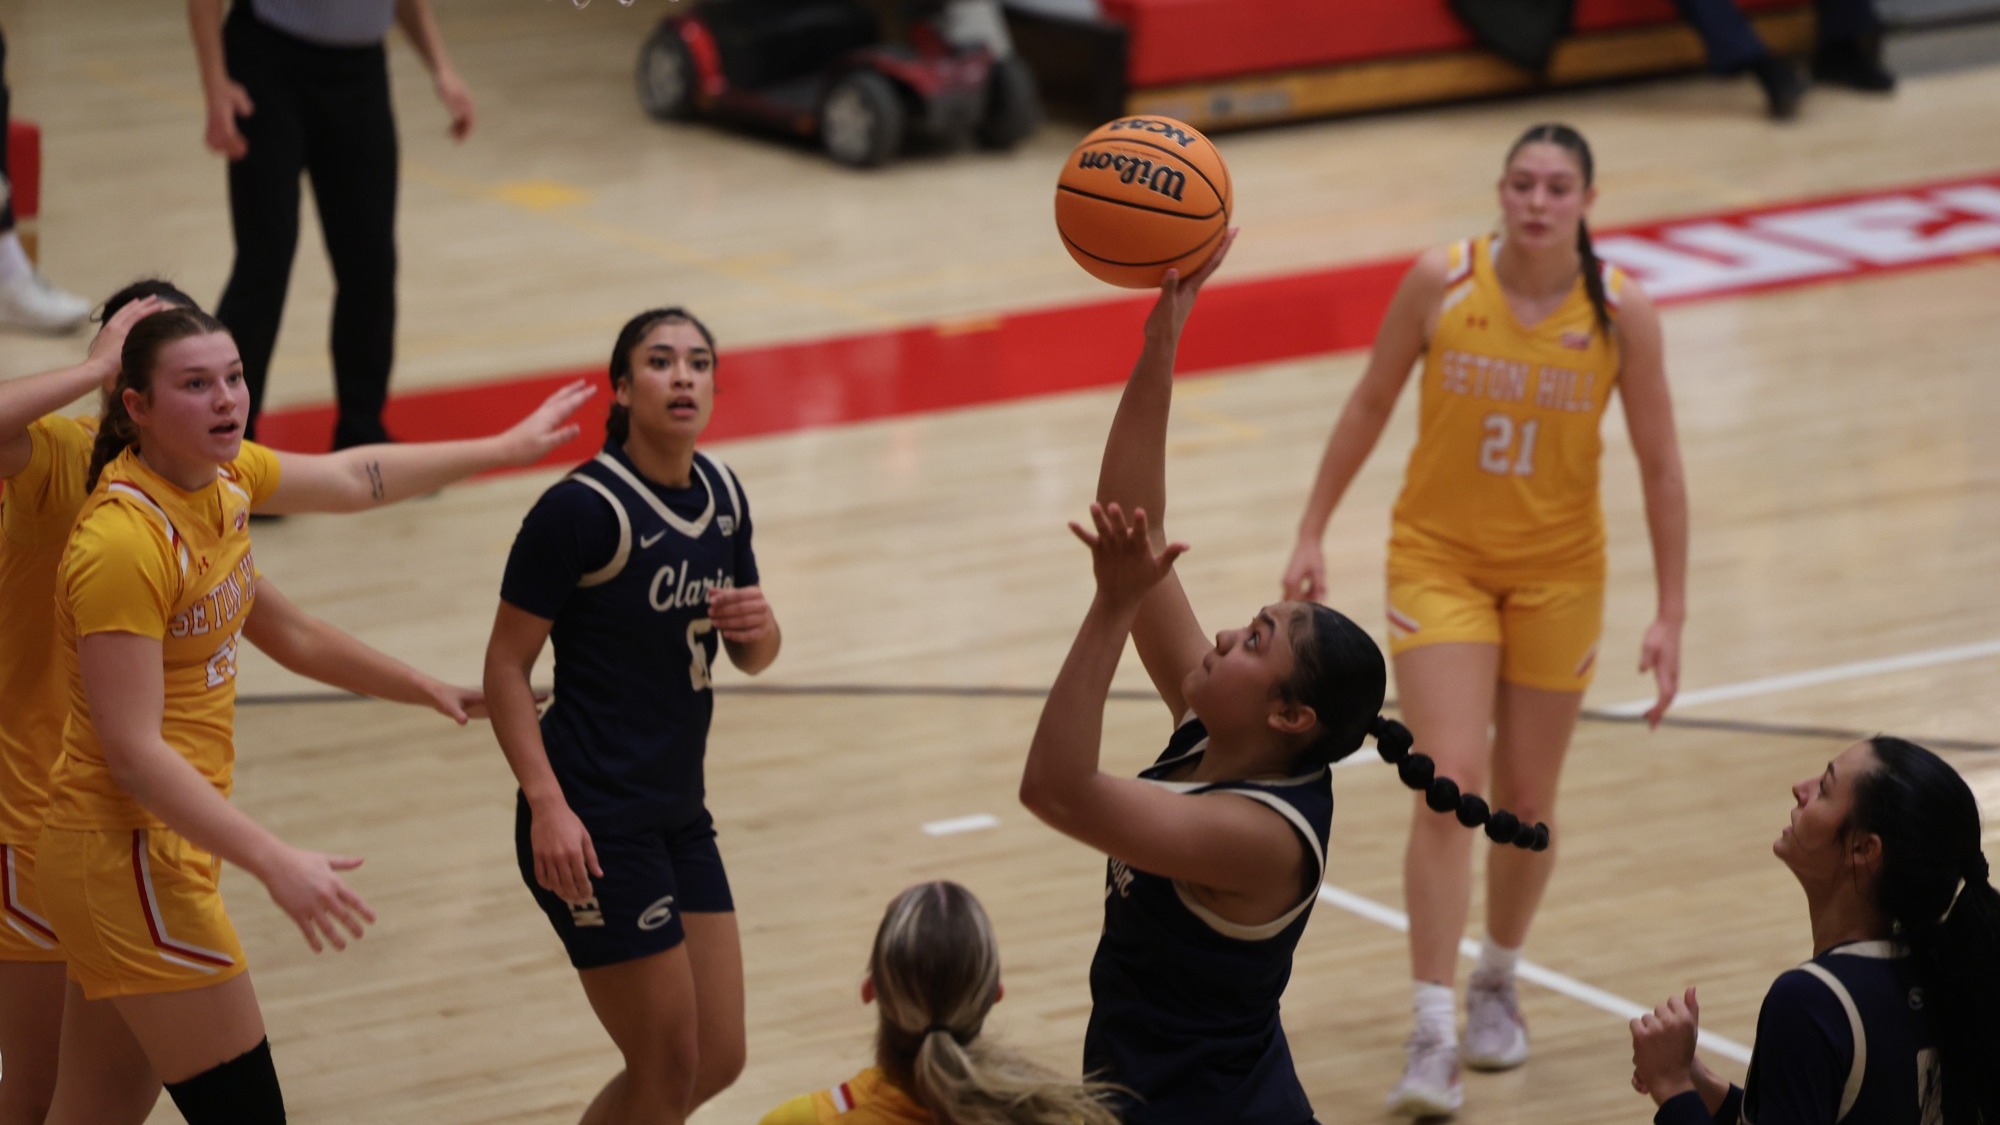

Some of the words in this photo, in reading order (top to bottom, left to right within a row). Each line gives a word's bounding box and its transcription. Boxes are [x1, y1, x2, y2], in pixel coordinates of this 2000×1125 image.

[1109, 118, 1196, 147] NCAA
[1078, 151, 1187, 202] Wilson
[1440, 350, 1530, 404] SETON
[1535, 364, 1596, 412] HILL
[1478, 412, 1539, 477] 21
[170, 571, 242, 638] SETON
